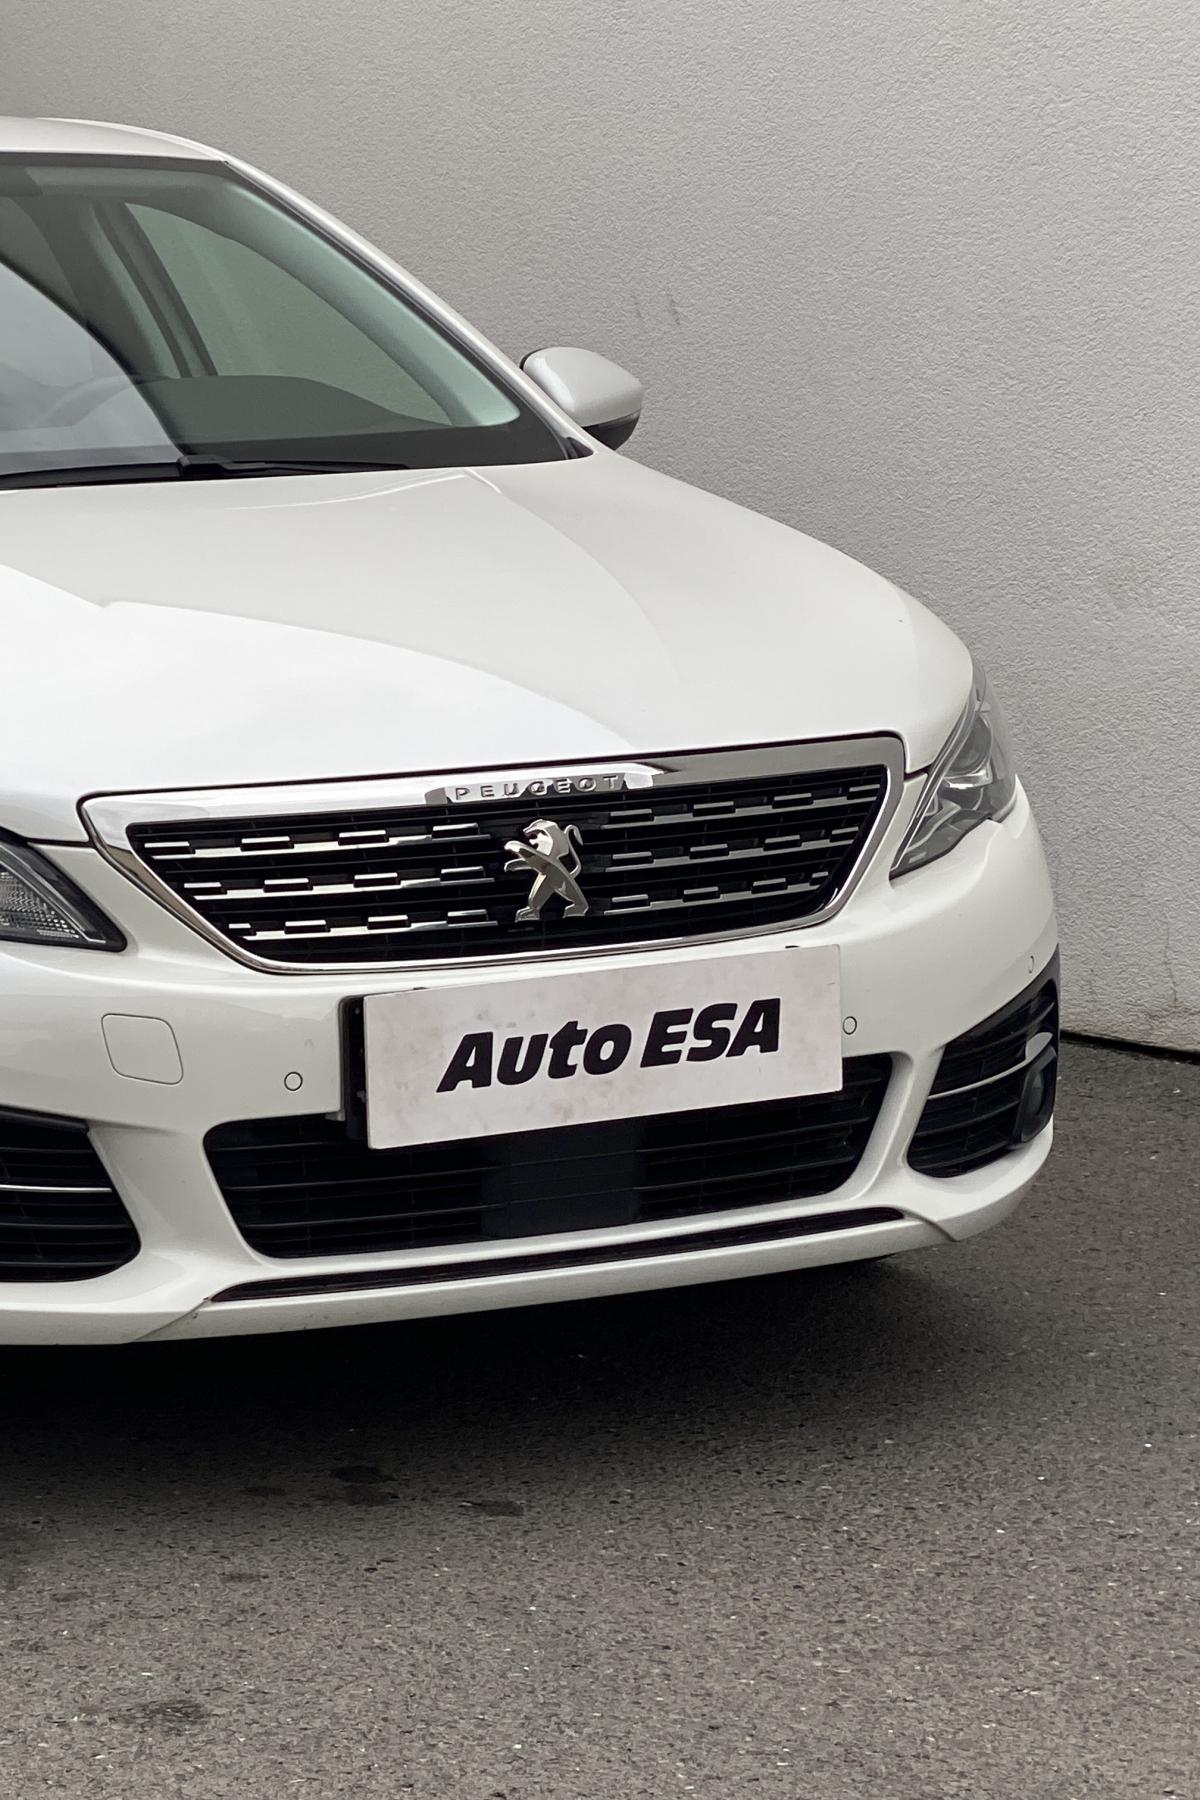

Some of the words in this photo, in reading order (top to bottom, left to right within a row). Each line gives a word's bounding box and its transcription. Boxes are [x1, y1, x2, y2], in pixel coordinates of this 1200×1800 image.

[455, 774, 619, 801] PEUGEOT
[436, 1020, 632, 1093] Auto
[640, 997, 781, 1068] ESA
